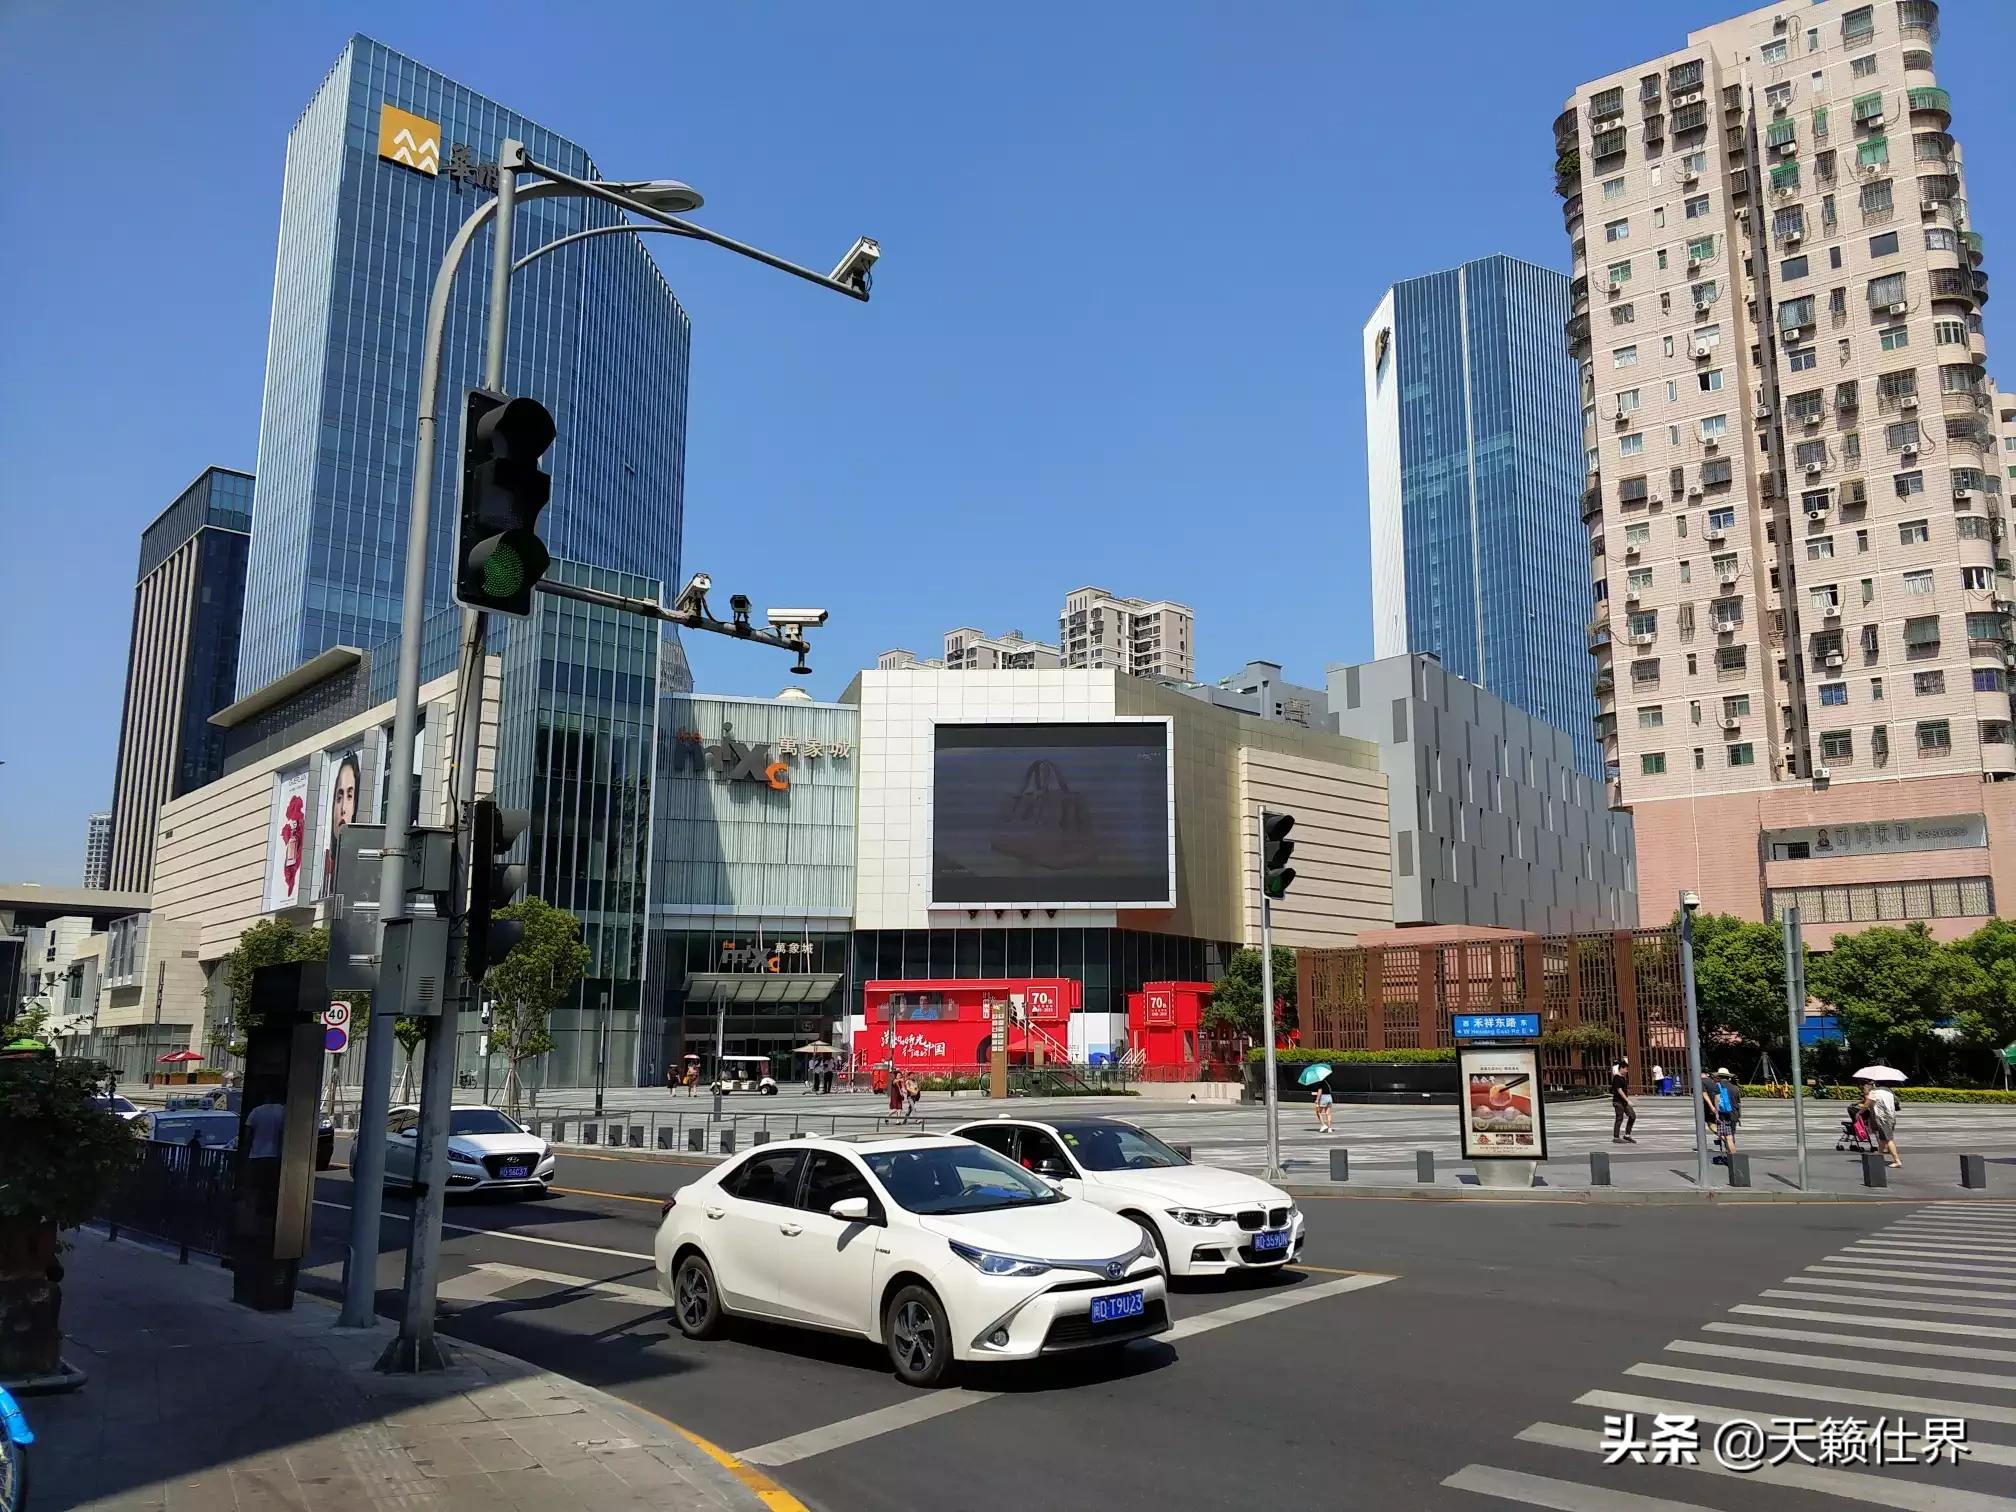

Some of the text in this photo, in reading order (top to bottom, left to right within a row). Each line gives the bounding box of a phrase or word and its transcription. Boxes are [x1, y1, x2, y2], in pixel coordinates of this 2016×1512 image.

[775, 942, 814, 954] 萬象城
[328, 1009, 344, 1020] 40
[1473, 1017, 1517, 1028] 禾祥东路
